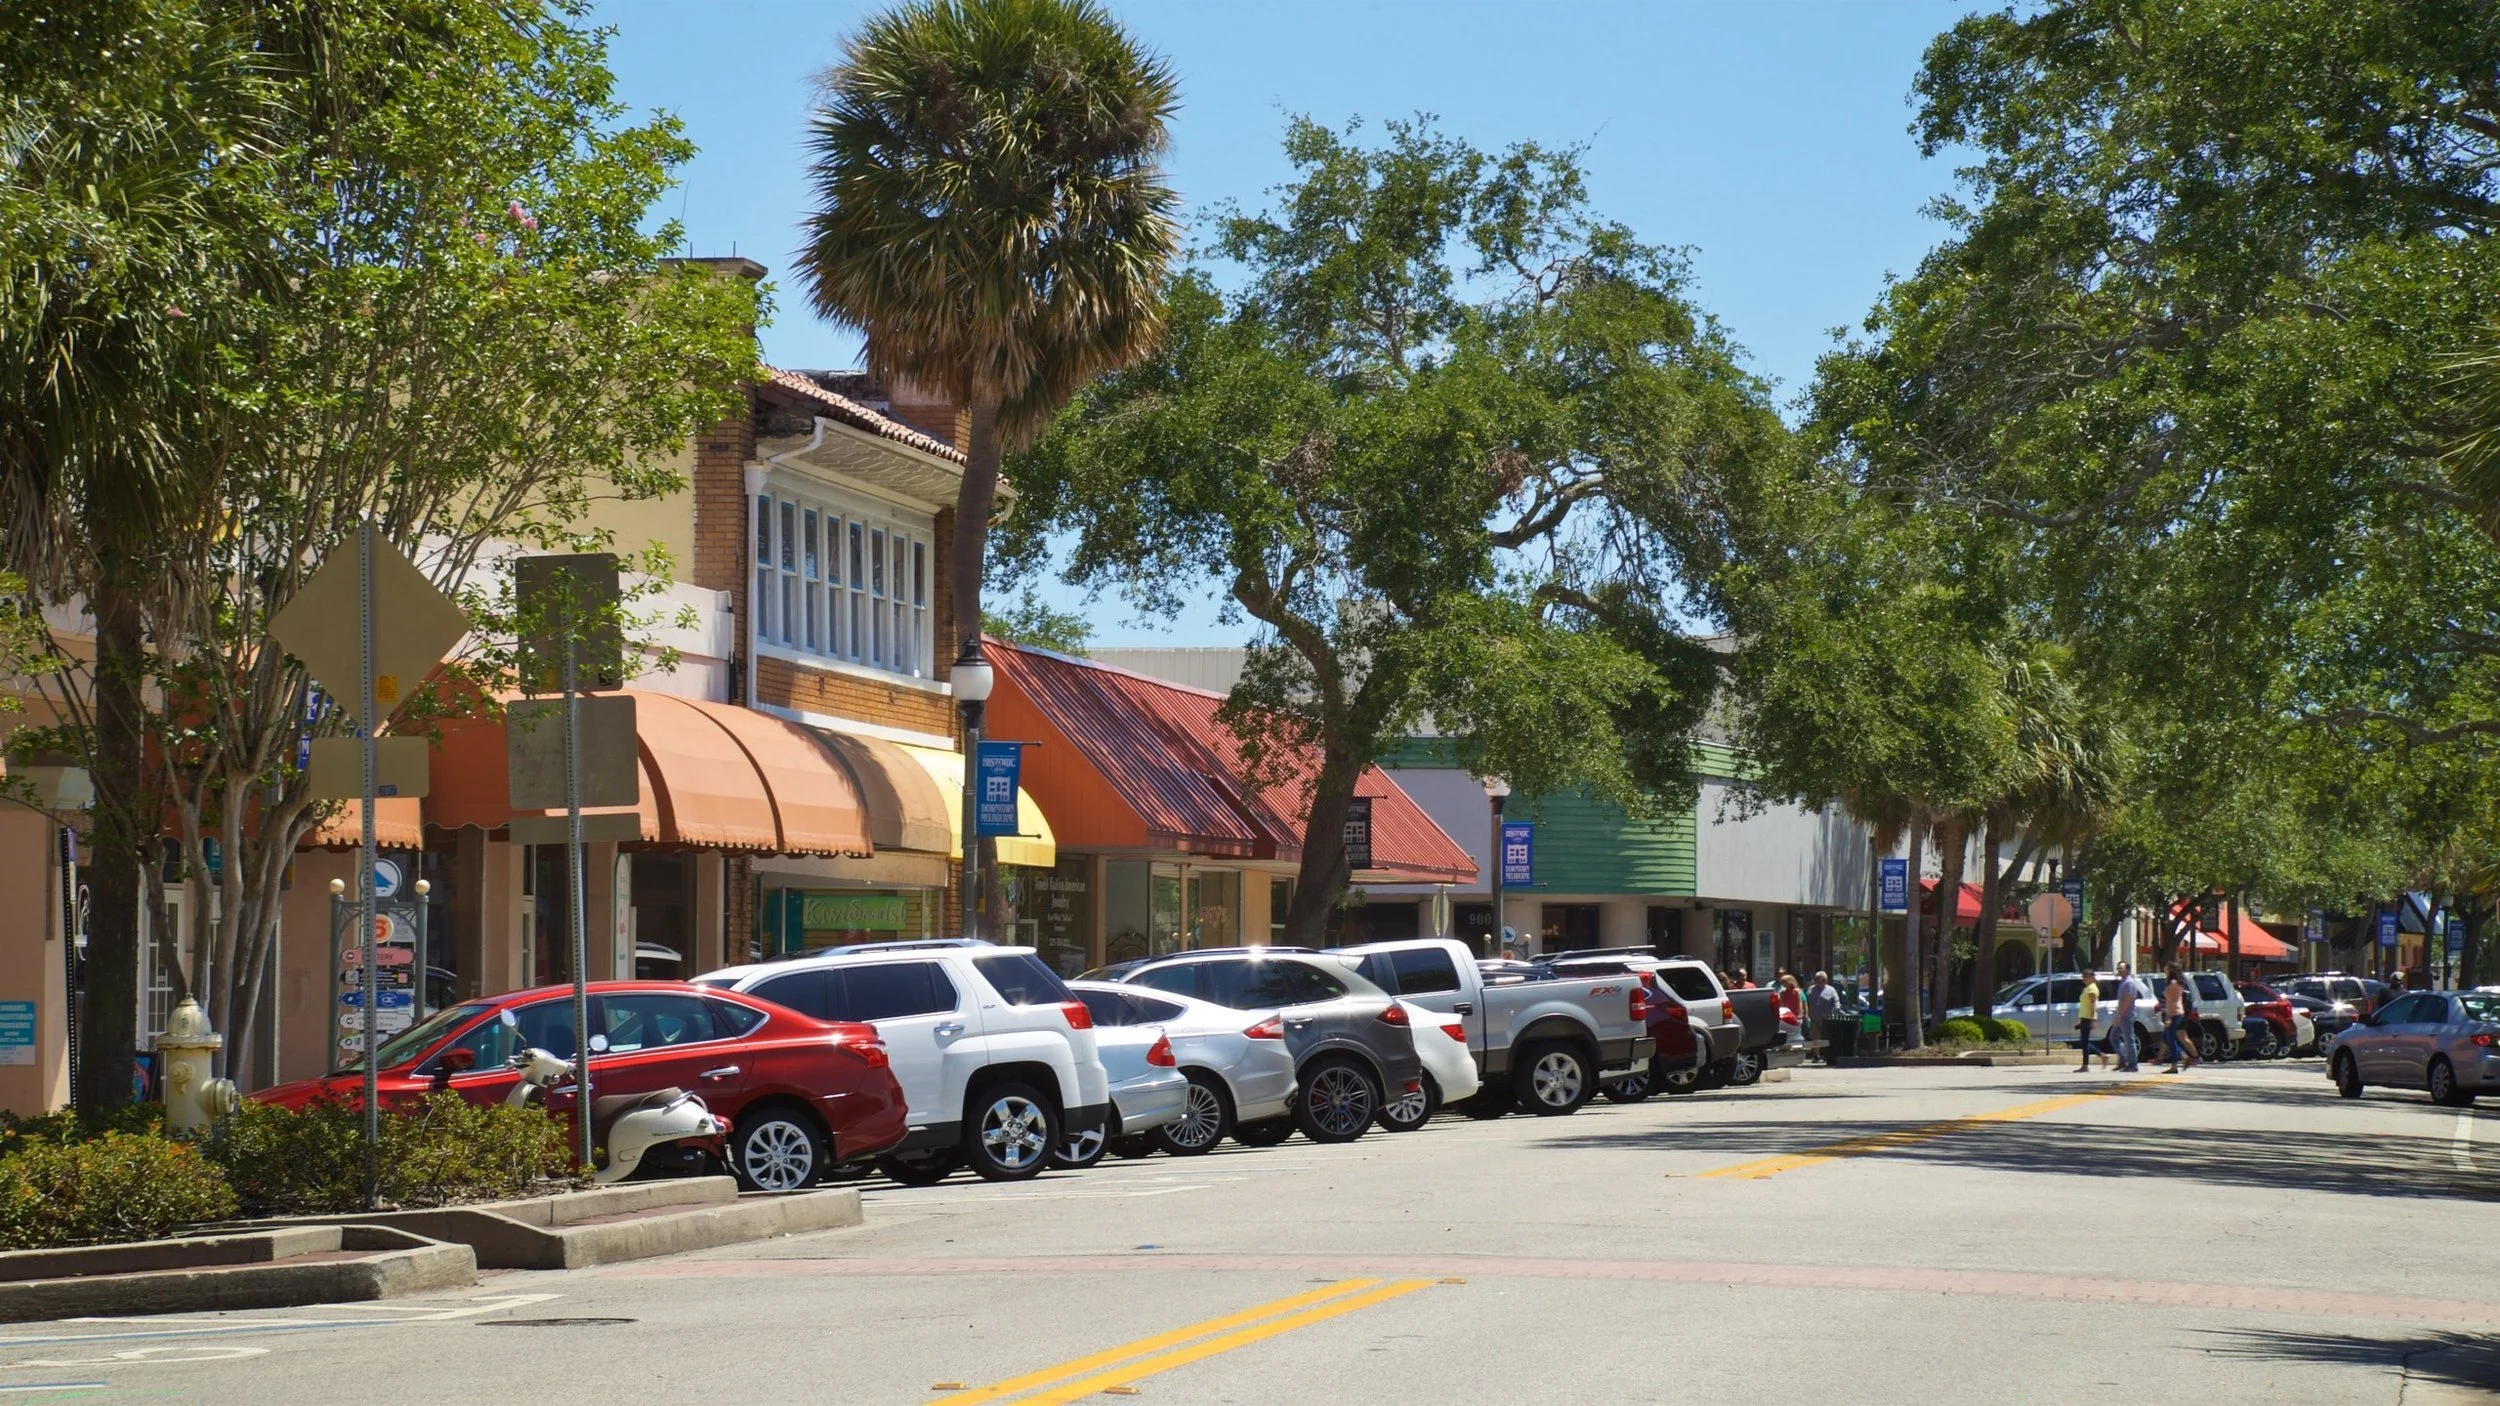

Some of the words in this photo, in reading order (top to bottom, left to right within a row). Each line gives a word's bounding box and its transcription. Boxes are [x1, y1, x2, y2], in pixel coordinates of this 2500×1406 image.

[982, 758, 1016, 768] HISTORIC
[981, 803, 1015, 813] DOWNTOWN
[980, 813, 1015, 823] MELBOURNE
[1469, 913, 1492, 926] 900
